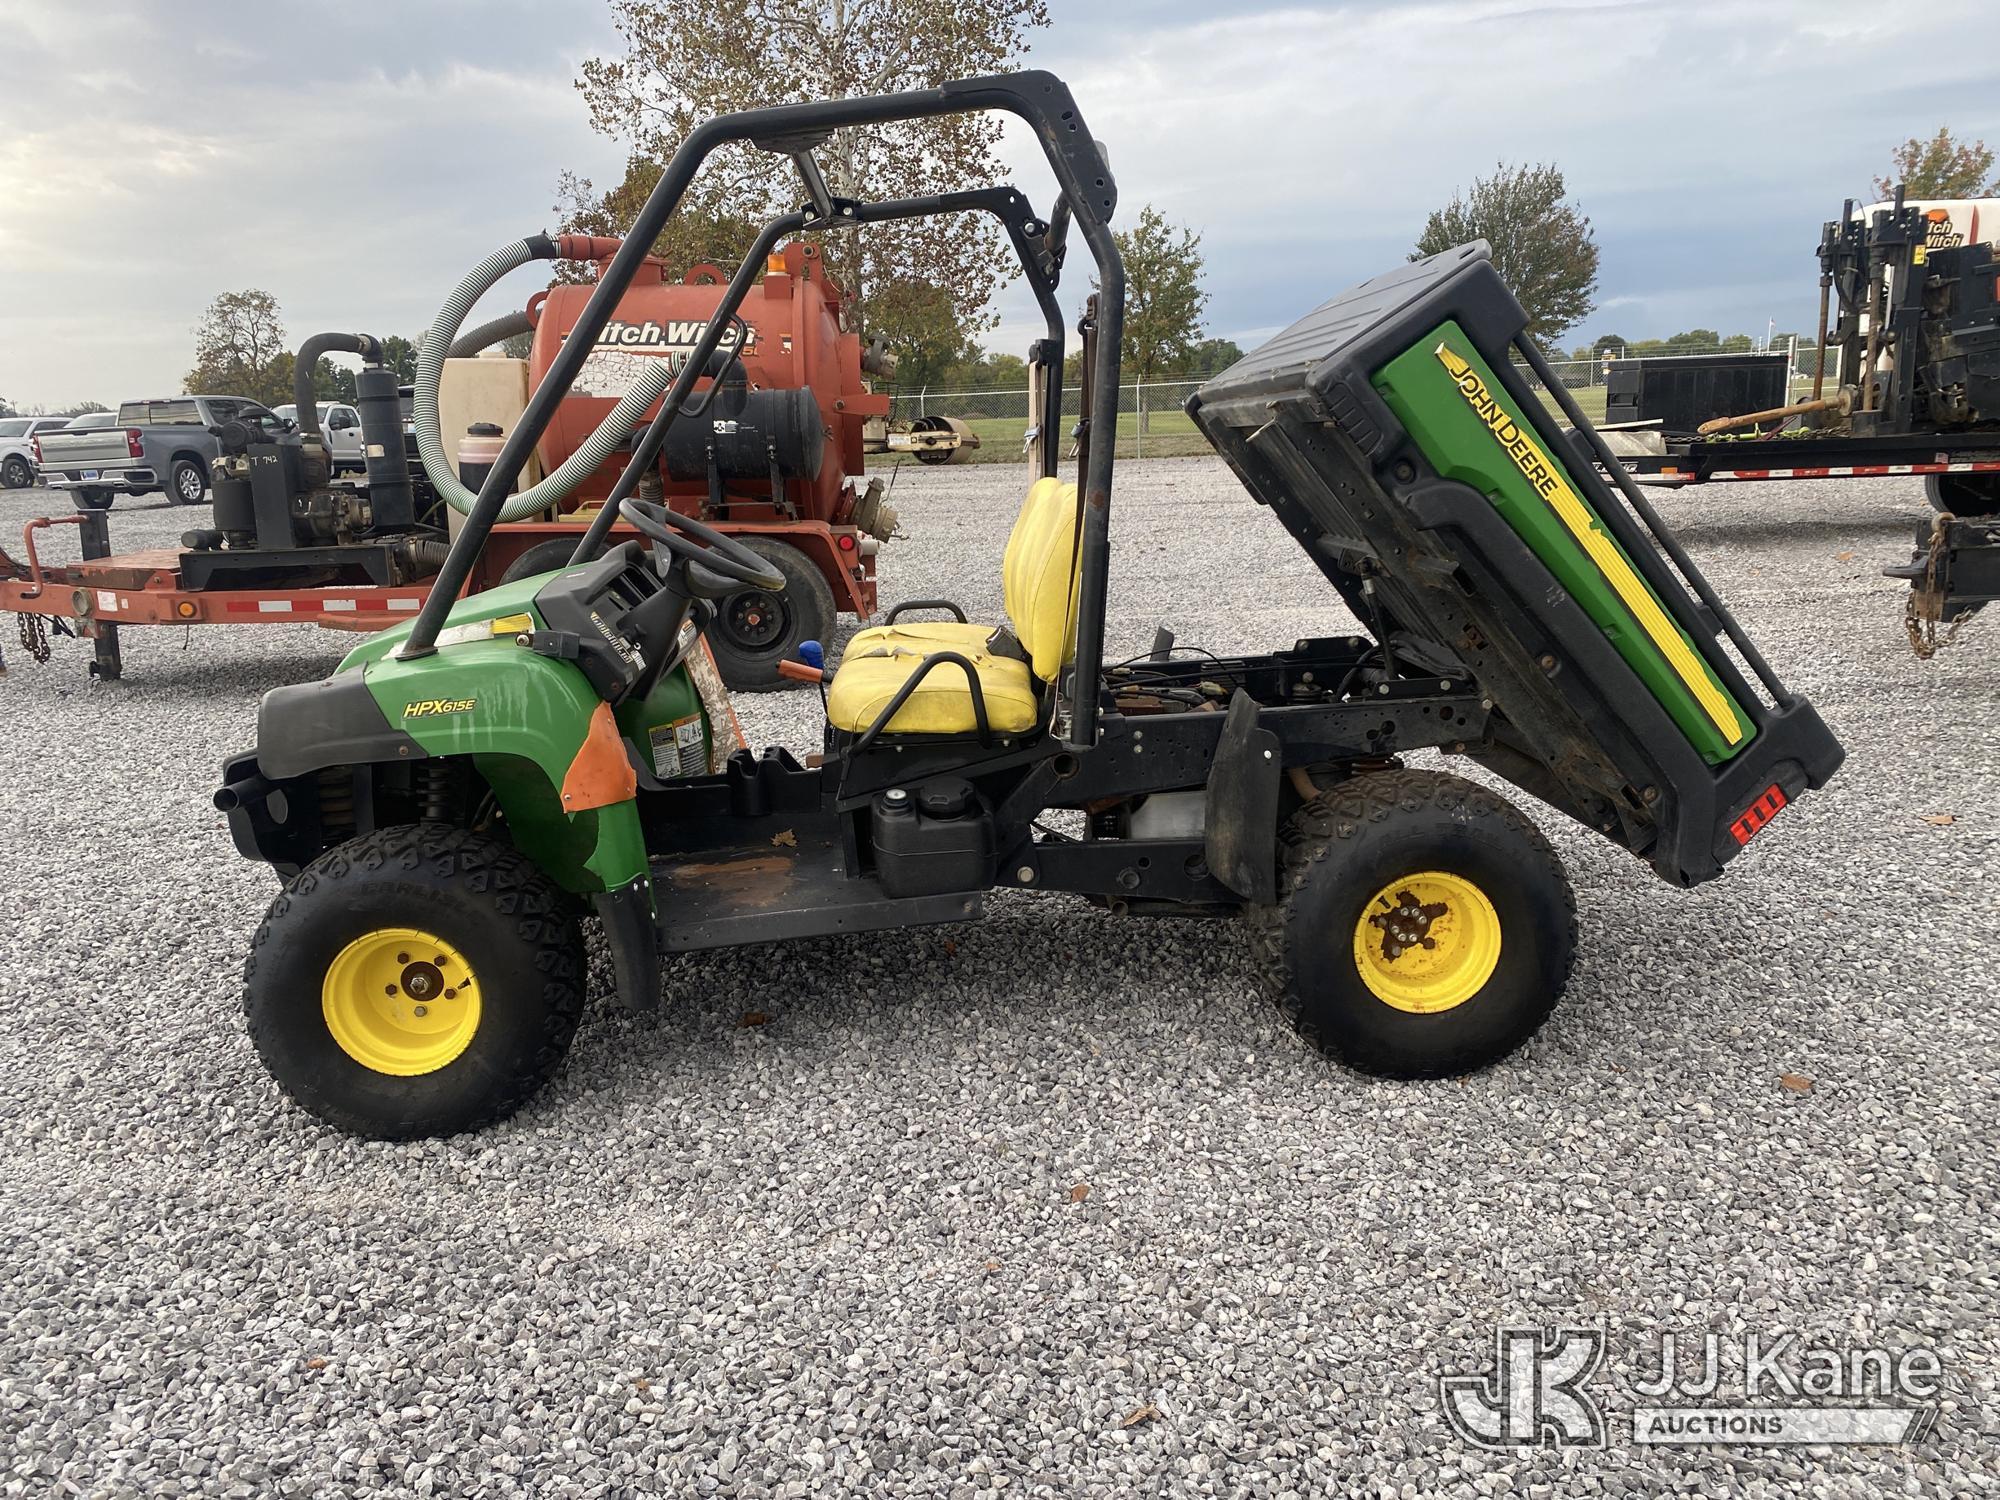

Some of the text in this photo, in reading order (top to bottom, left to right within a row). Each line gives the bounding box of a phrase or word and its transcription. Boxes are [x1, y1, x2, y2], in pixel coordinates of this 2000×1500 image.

[1926, 220, 1953, 234] tch
[598, 321, 757, 344] itch Wich
[1450, 366, 1559, 497] JOHN DEERE
[403, 699, 476, 718] HPX615E
